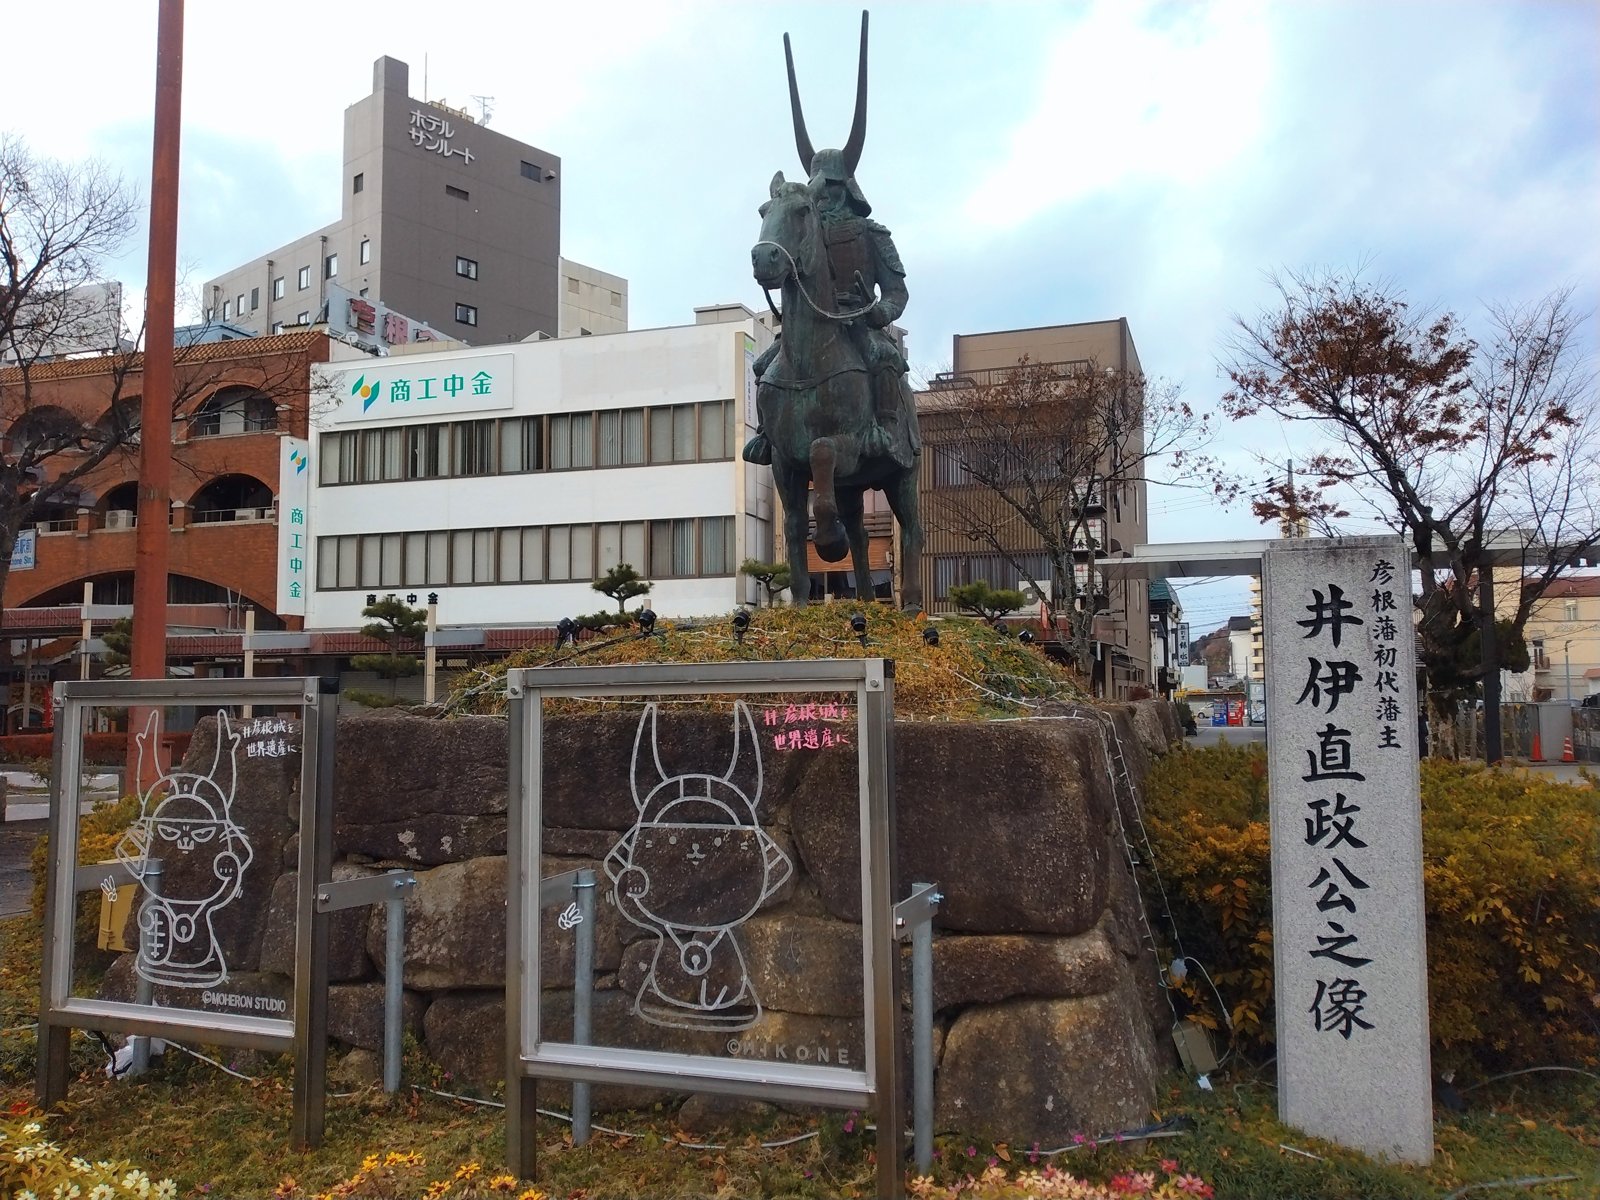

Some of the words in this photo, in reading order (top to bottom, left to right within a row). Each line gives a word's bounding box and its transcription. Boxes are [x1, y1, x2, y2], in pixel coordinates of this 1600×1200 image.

[410, 109, 455, 138] ホテル
[408, 127, 475, 165] サンルート
[390, 371, 493, 403] 商工中金
[289, 508, 304, 599] 商工中金
[366, 591, 438, 607] 商工中金
[1368, 559, 1402, 750] 彦根藩初代藩主
[246, 739, 298, 758] 世界遺産に
[774, 728, 850, 751] 世界遺産に
[1296, 583, 1376, 1040] 井伊直政公之像
[202, 990, 253, 1009] ©MOHERON
[254, 997, 287, 1013] STUDIO
